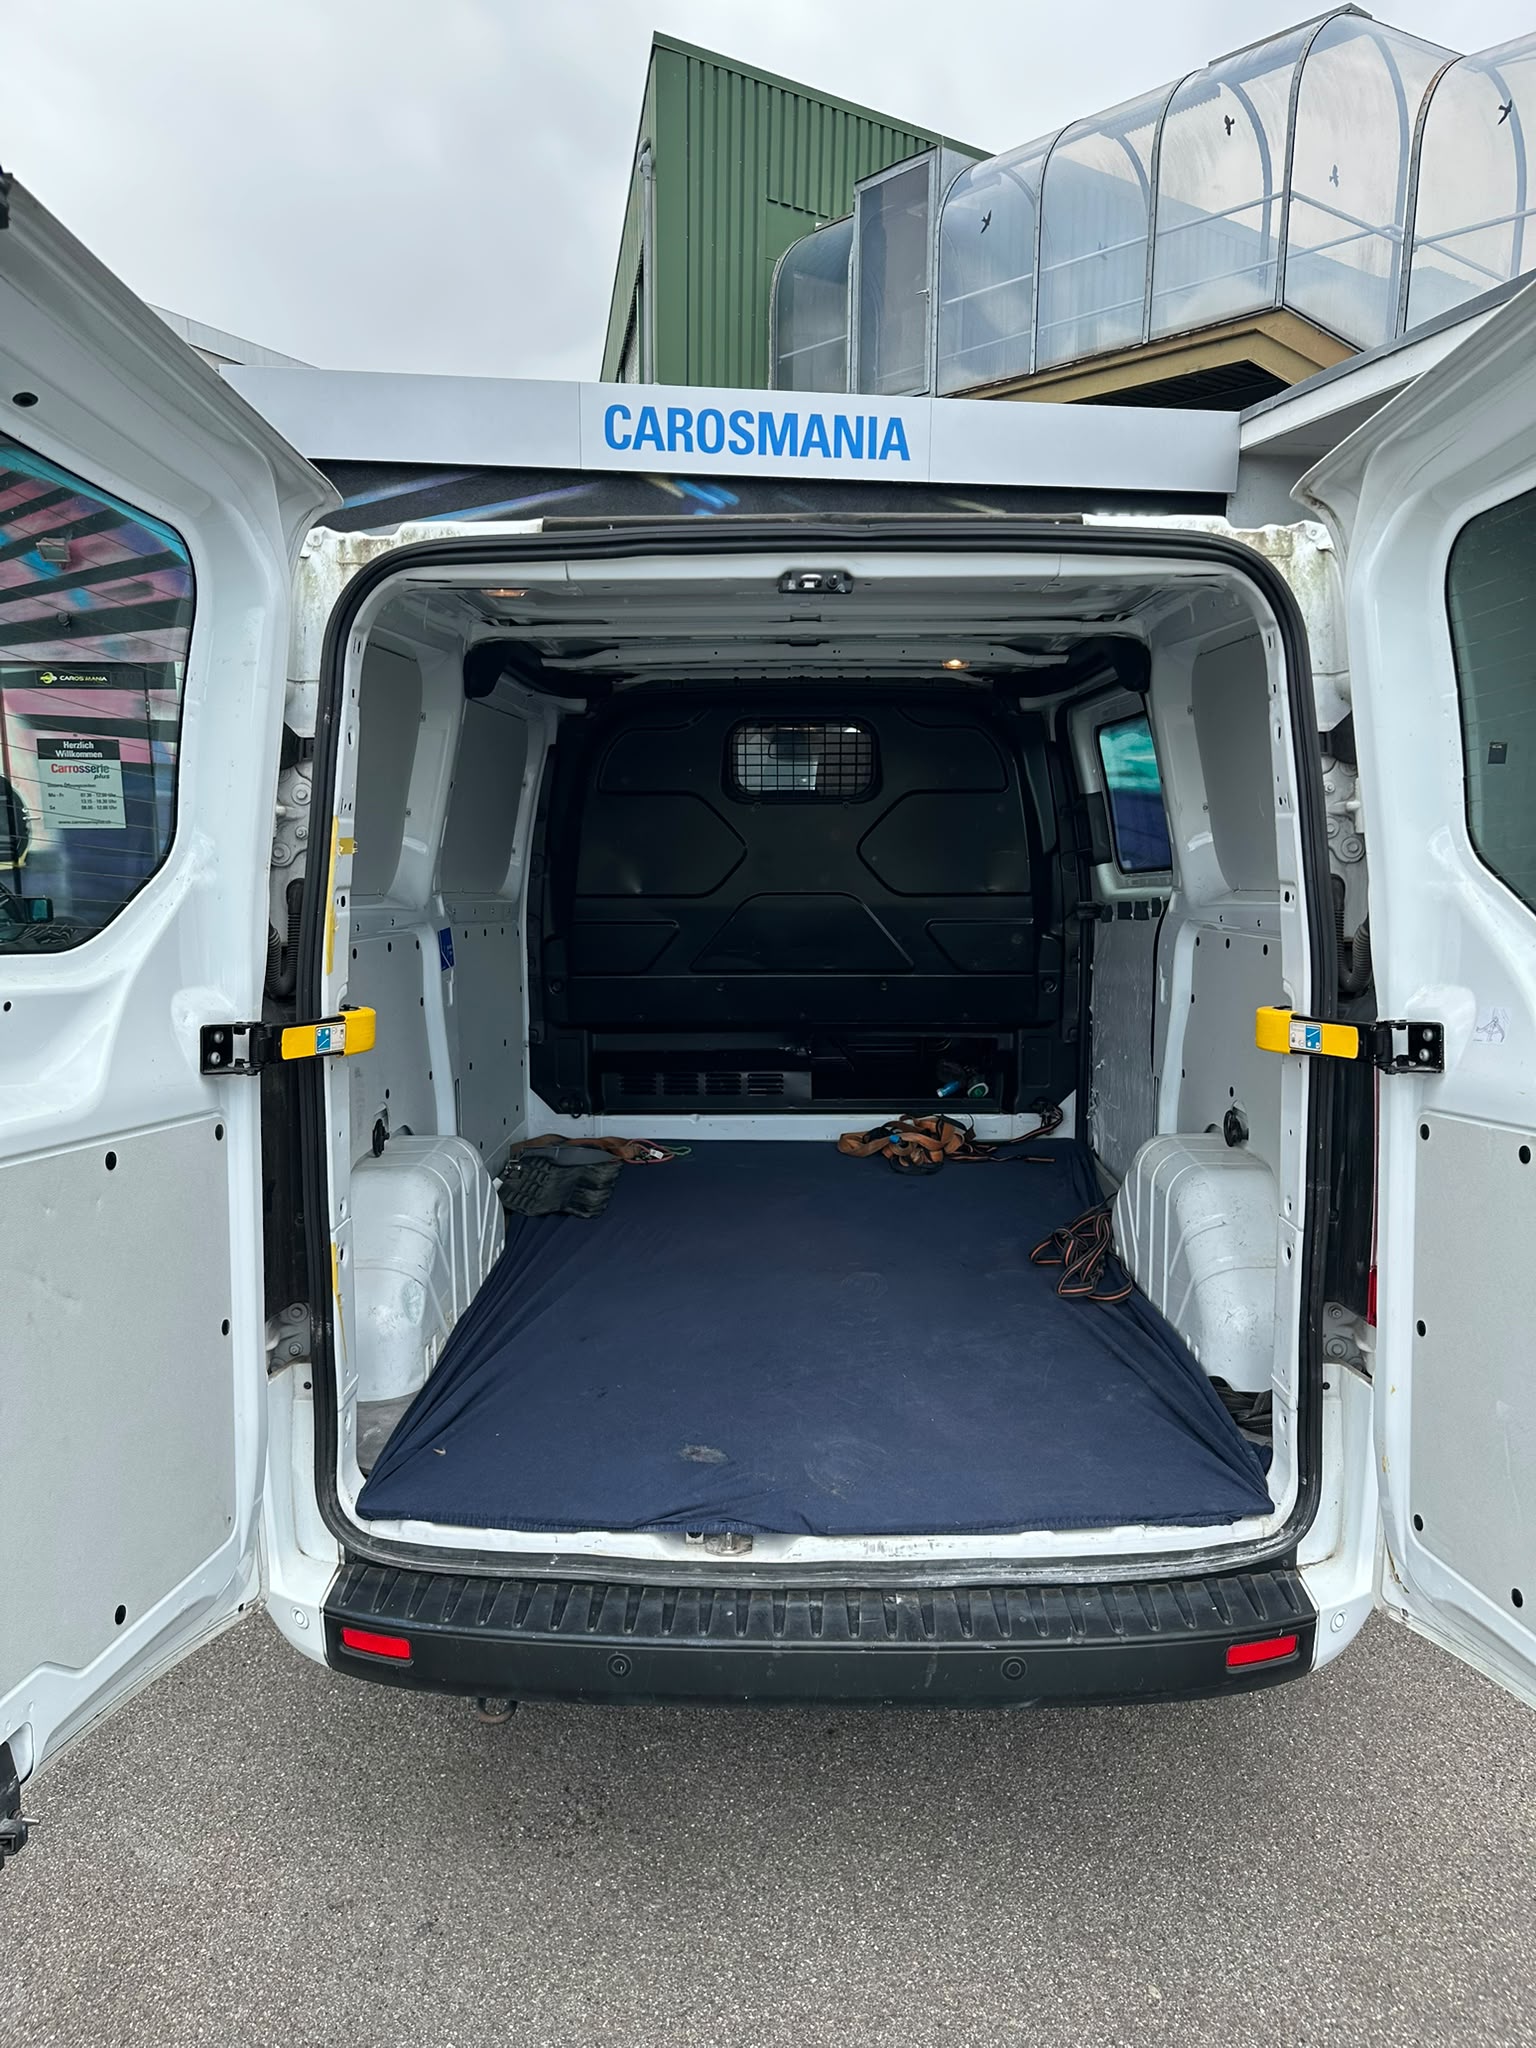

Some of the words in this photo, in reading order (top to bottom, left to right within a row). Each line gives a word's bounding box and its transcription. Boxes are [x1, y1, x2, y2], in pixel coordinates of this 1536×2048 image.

[604, 403, 911, 461] CAROSMANIA
[63, 740, 94, 749] Herzlich
[55, 750, 103, 758] Willkommen
[51, 763, 110, 773] Carrosserie
[94, 773, 110, 781] plus
